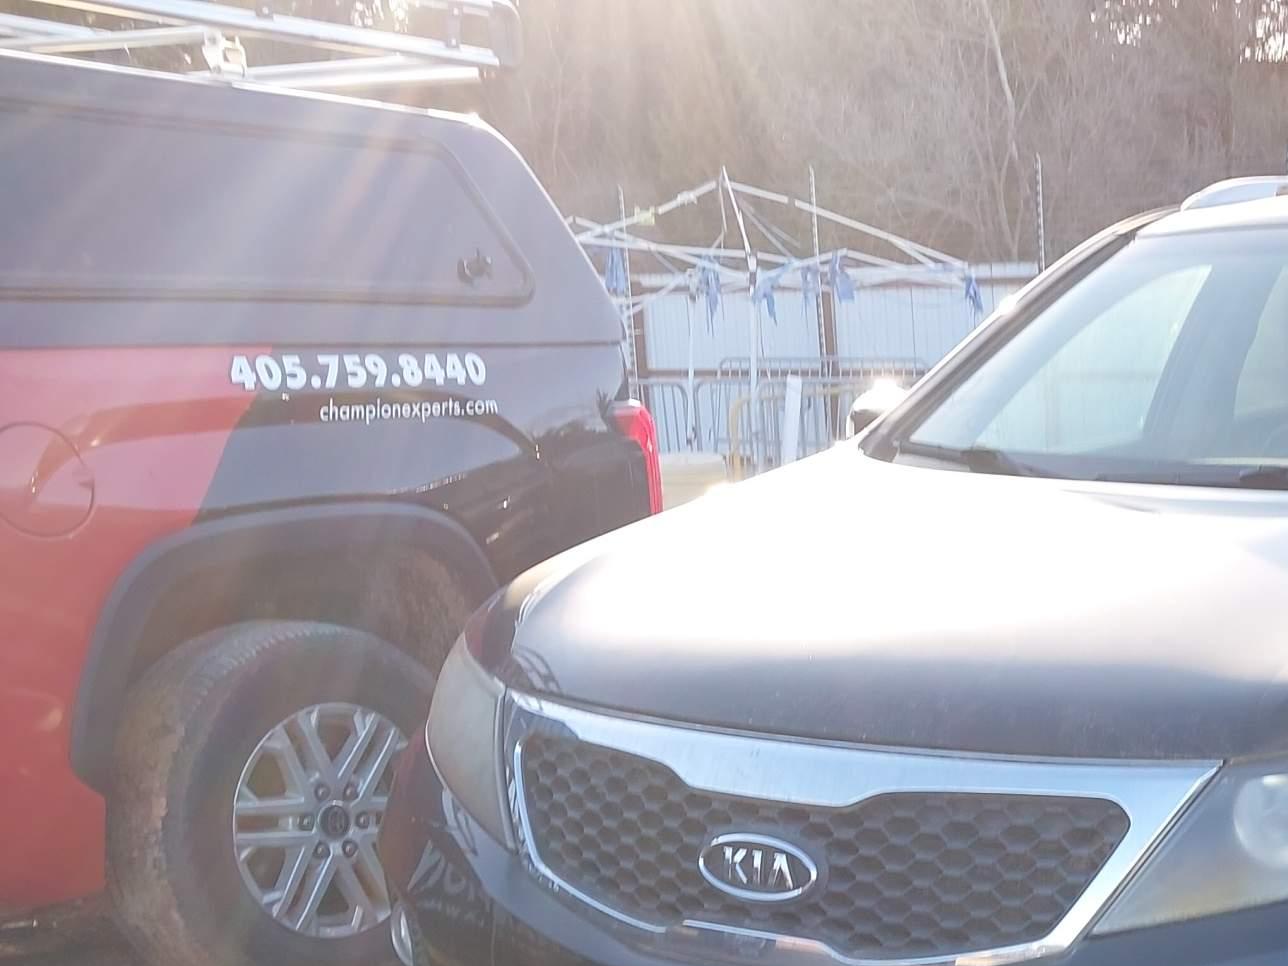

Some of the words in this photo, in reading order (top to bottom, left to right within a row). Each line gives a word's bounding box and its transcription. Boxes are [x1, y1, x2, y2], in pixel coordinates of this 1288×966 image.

[230, 352, 487, 391] 405.759.8440
[319, 396, 499, 425] championexperts.com
[722, 845, 794, 890] KIA
